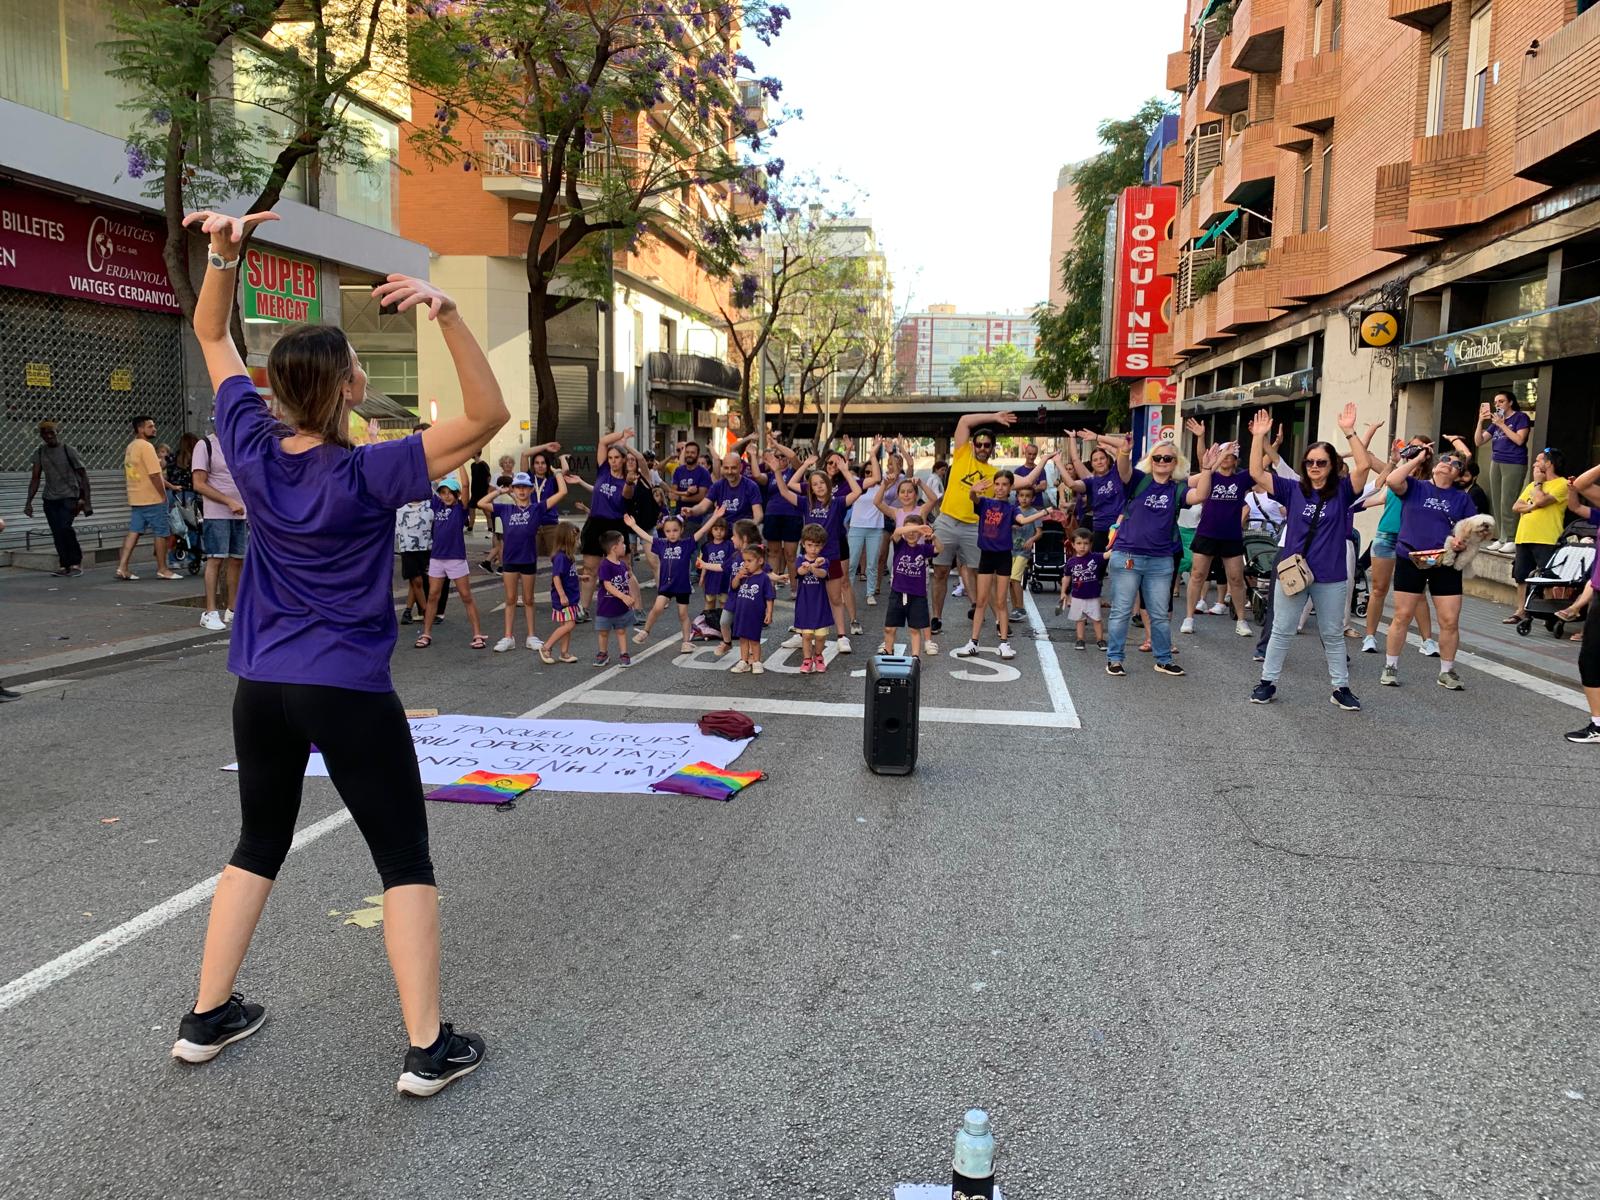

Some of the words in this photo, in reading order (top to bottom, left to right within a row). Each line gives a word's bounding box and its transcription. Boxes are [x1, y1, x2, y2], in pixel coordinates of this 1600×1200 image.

[3, 210, 65, 242] BILLETES
[105, 219, 155, 243] VIATGES
[246, 249, 316, 300] SUPER
[1125, 203, 1155, 370] JOGUINES
[69, 275, 115, 296] VIATGES
[118, 284, 180, 307] CERDANYOL
[256, 291, 310, 323] MERCAT
[1460, 333, 1502, 361] CaixaBank
[1162, 431, 1175, 439] 30
